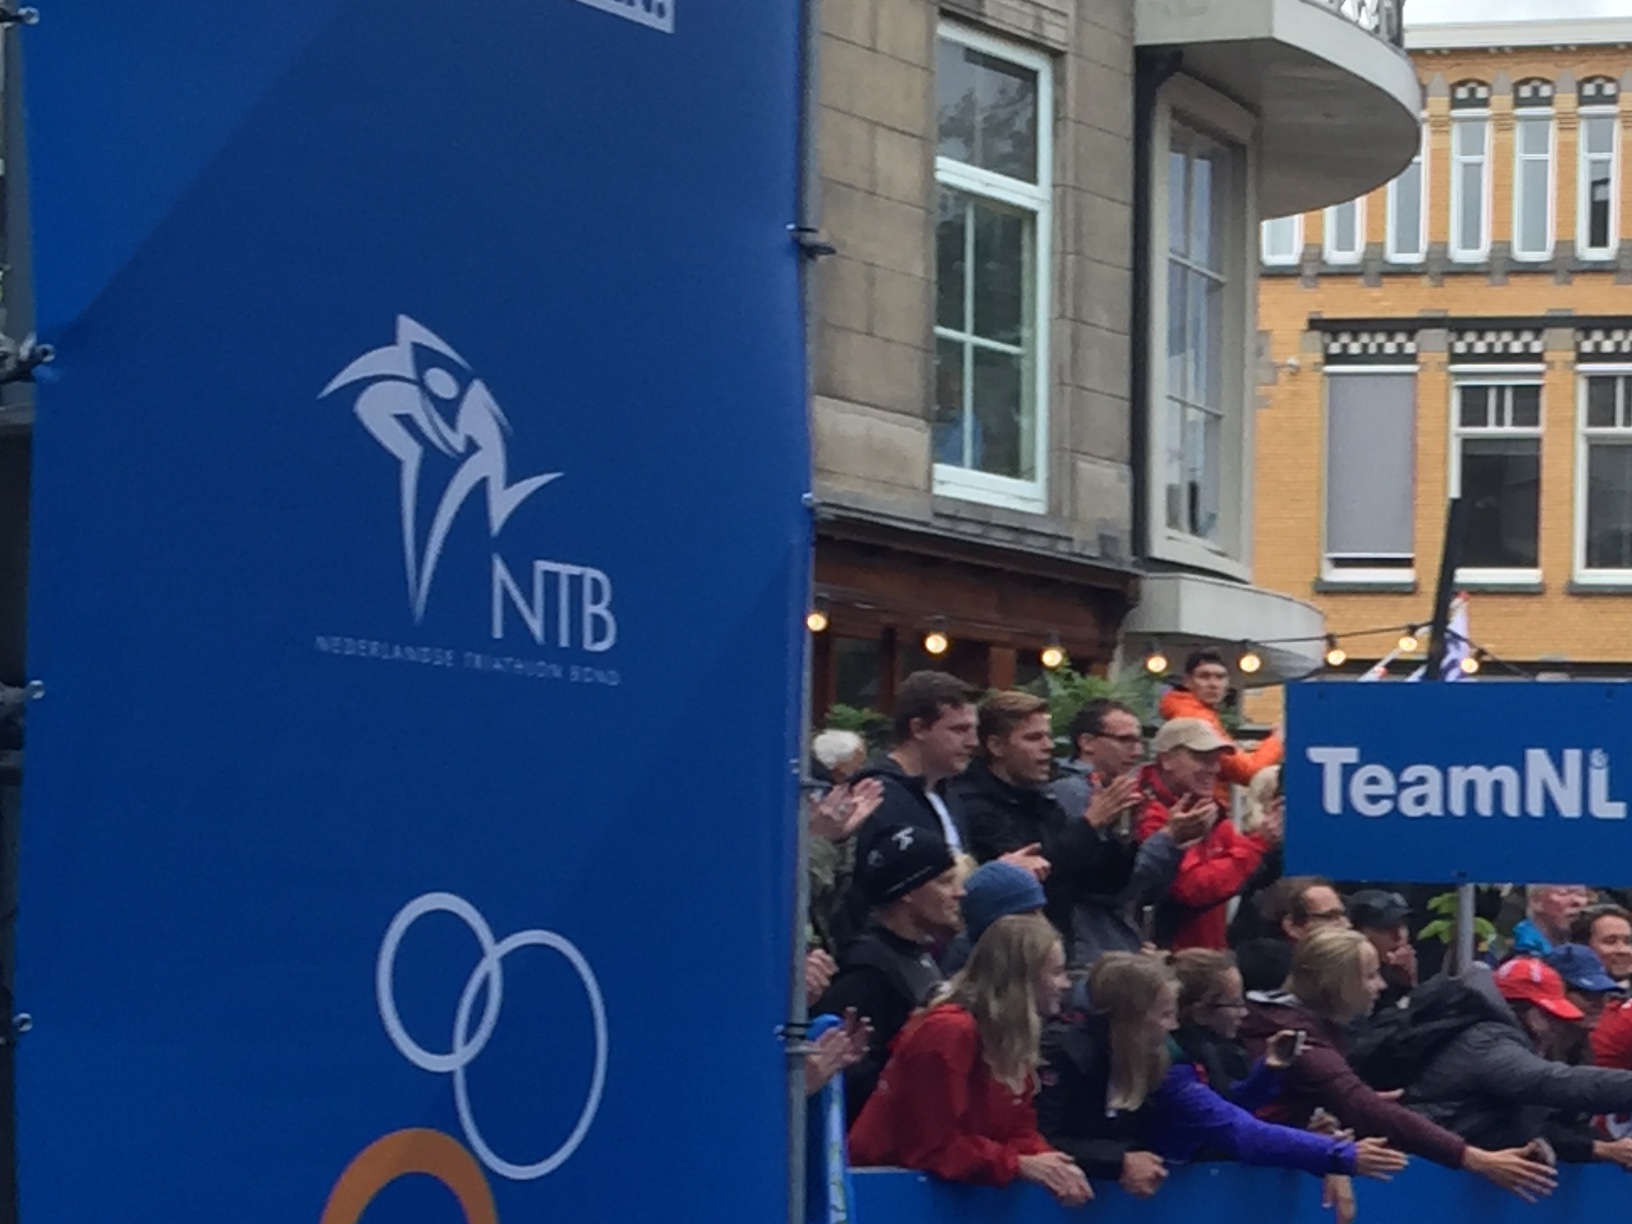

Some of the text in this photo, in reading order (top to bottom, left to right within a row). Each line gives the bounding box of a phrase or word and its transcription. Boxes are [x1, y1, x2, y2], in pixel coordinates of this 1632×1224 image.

[492, 553, 617, 652] NTB
[315, 635, 455, 667] NEDERLANDSE
[1305, 747, 1627, 819] TeamNL
